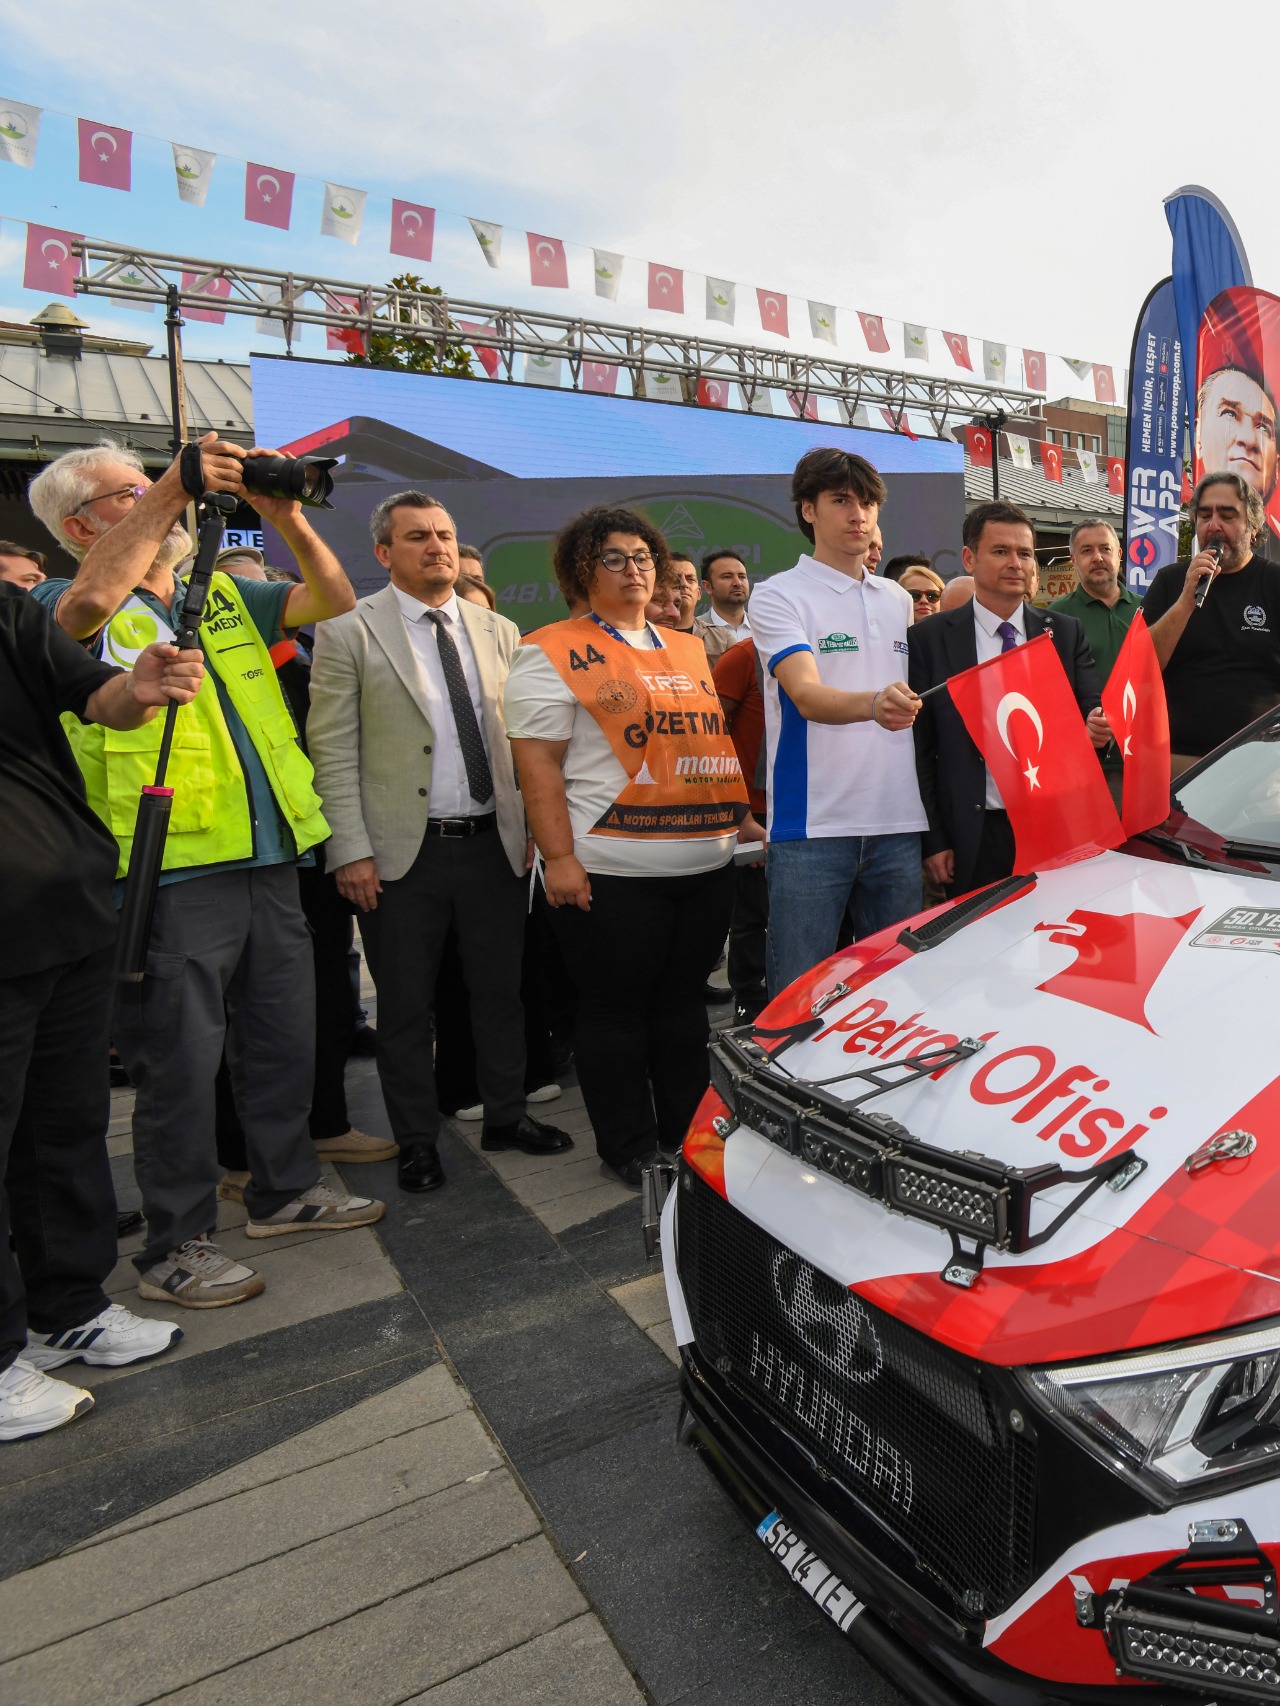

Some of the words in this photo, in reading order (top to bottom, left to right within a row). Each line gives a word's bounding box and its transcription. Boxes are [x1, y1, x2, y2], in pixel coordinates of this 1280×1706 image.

[1145, 332, 1158, 374] KEŞFET
[1142, 377, 1156, 412] İNDİR,
[1170, 340, 1181, 458] www.powerapp.com.tr
[1141, 414, 1152, 453] HEMEN
[1158, 470, 1182, 540] APP
[1129, 466, 1157, 587] POWER
[207, 614, 244, 636] MEDY
[569, 643, 606, 671] 44
[640, 674, 694, 691] TRS
[675, 750, 743, 776] maxim
[623, 814, 658, 826] MOTOR
[659, 814, 702, 826] SPORLARI
[969, 1045, 1168, 1166] Ofisi
[751, 1331, 913, 1515] HYUNDAI
[764, 1521, 799, 1561] SB
